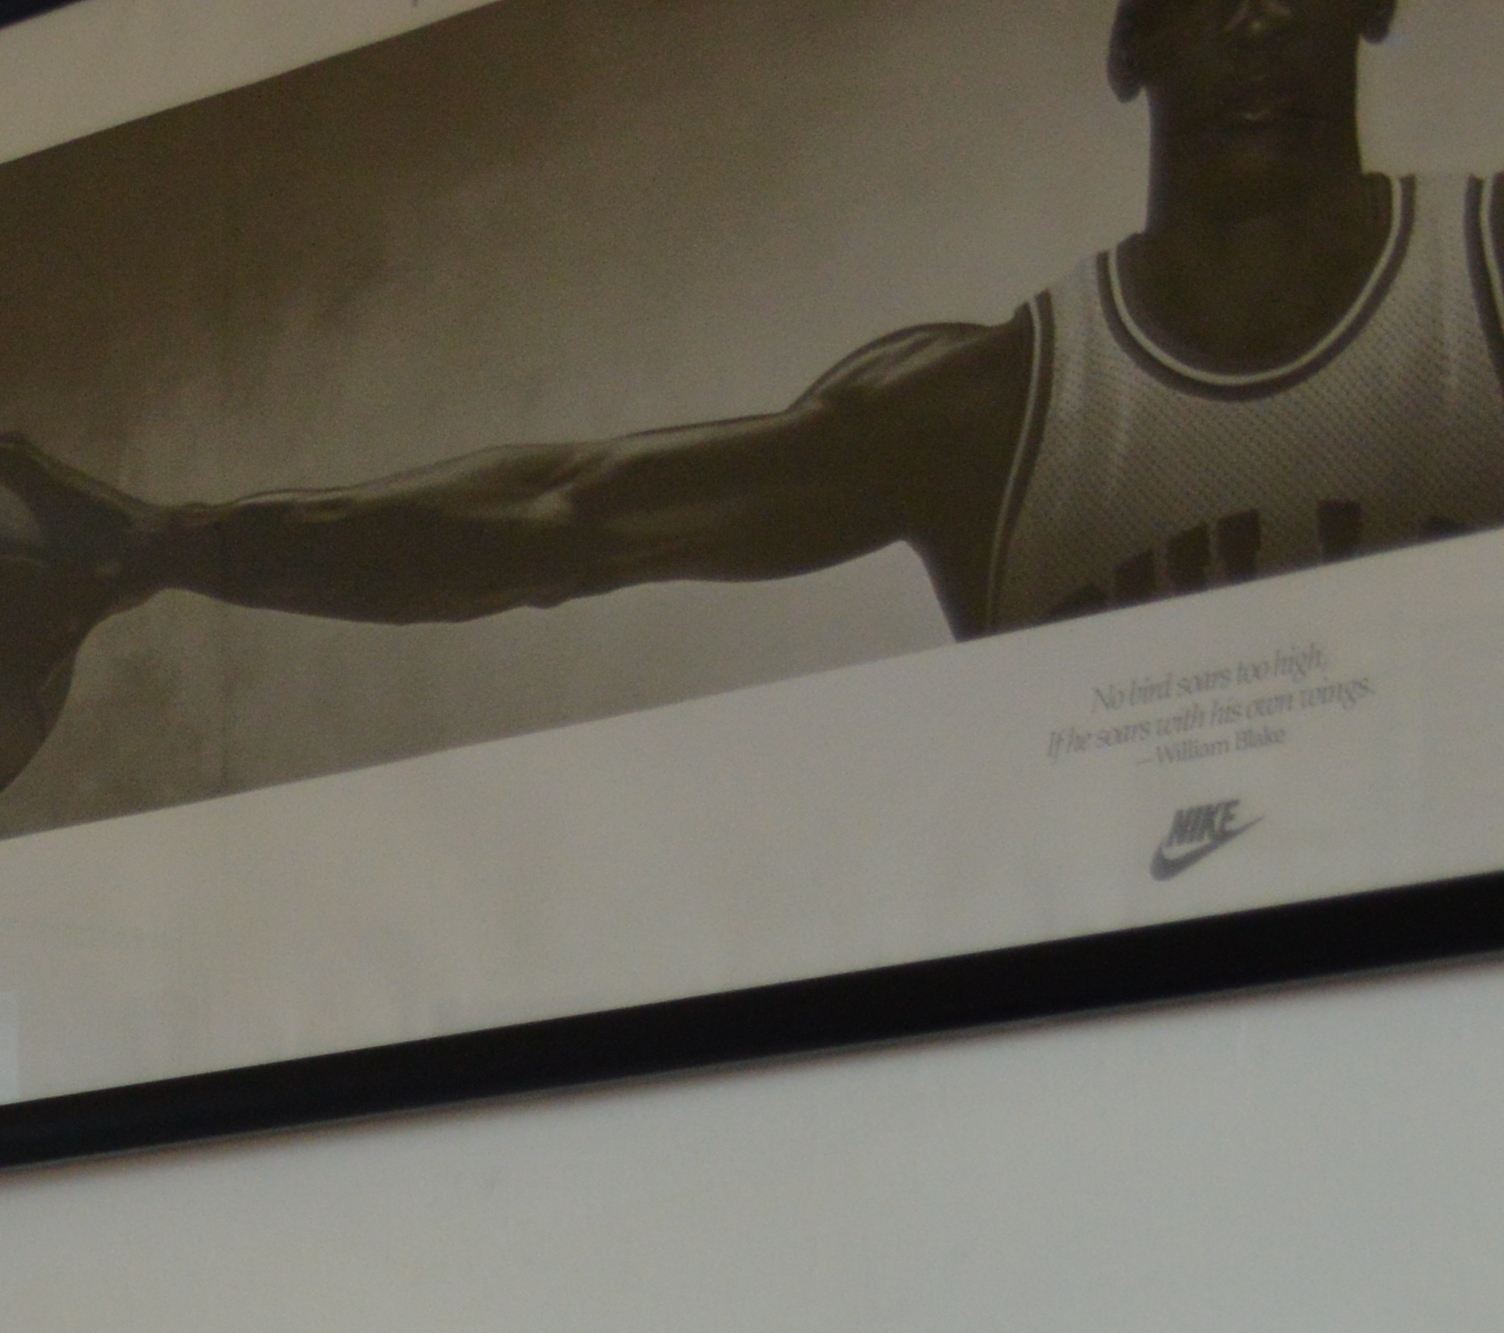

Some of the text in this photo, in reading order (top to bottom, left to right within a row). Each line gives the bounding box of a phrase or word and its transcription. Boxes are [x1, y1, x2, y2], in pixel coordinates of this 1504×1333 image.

[1092, 684, 1126, 713] No
[1128, 671, 1171, 707] bird
[1176, 667, 1232, 698] soars
[1236, 658, 1269, 686] too
[1067, 725, 1092, 754] he
[1095, 719, 1152, 749] soars
[1156, 702, 1207, 738] with
[1210, 697, 1243, 726] his
[1246, 691, 1294, 720] own
[1234, 725, 1287, 752] Blake
[1169, 799, 1242, 848] NIKE
